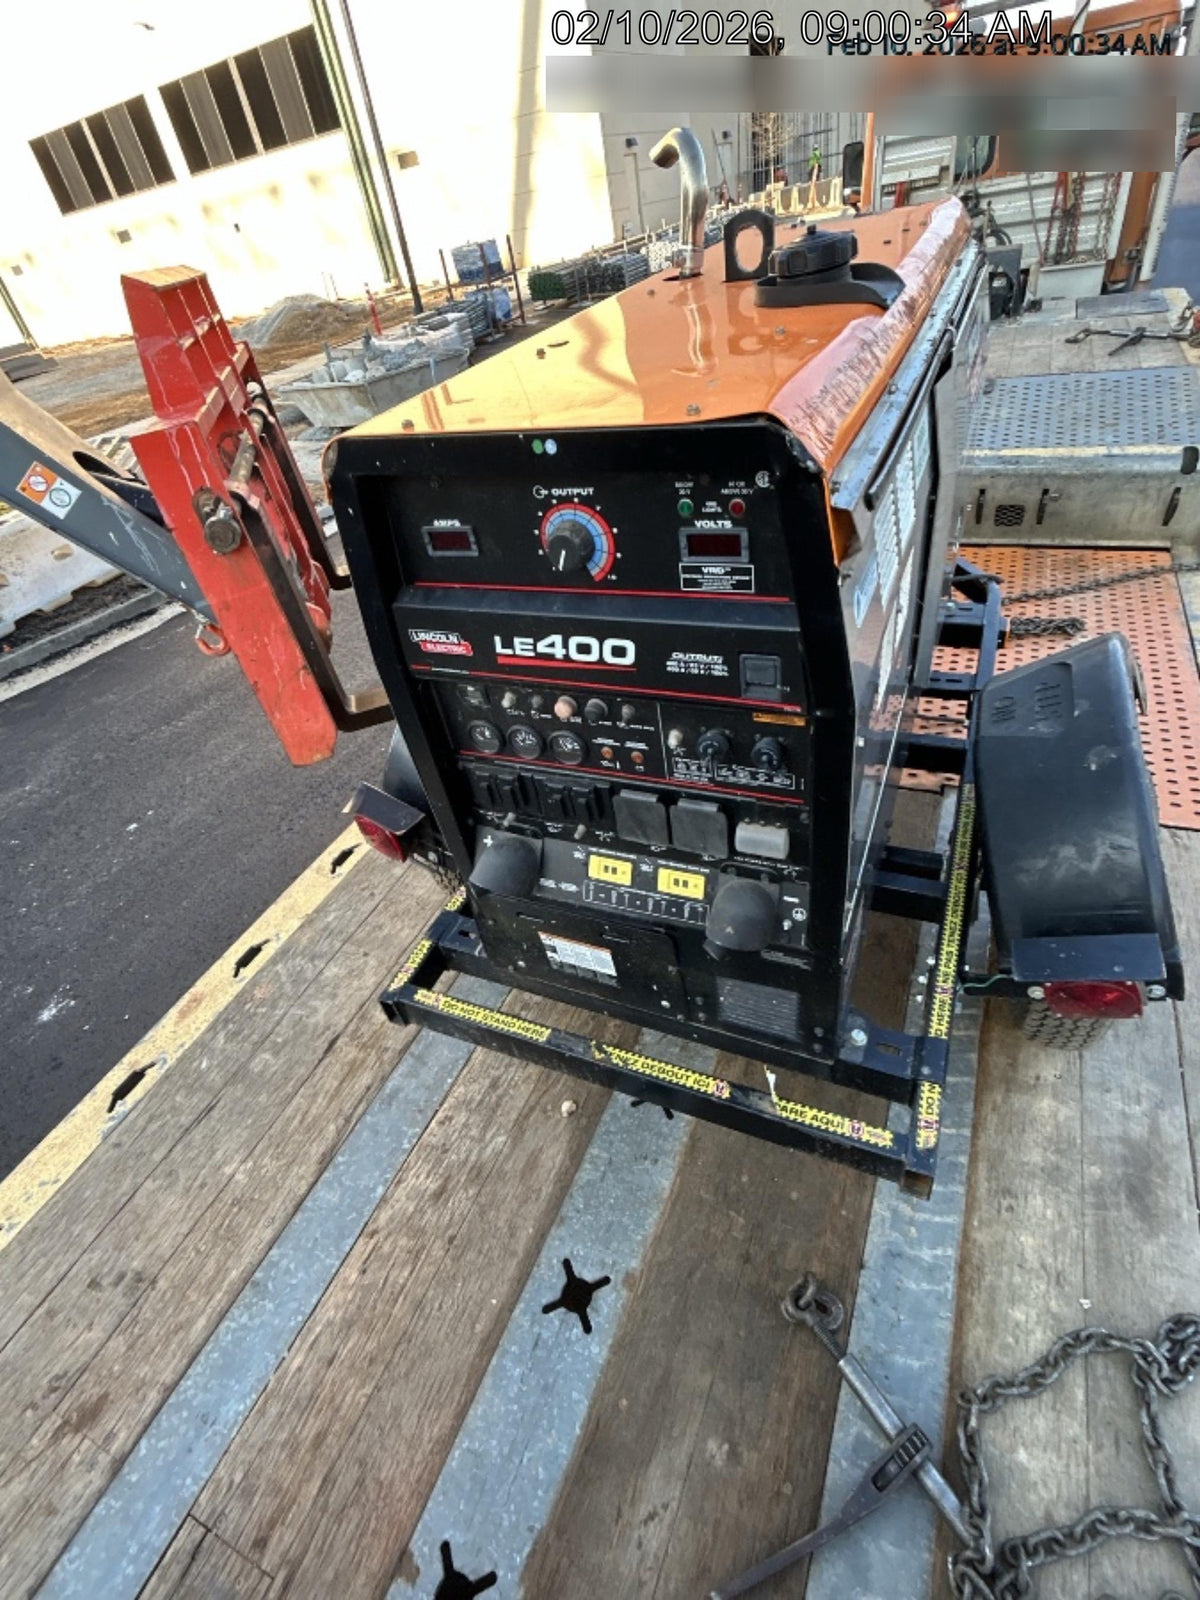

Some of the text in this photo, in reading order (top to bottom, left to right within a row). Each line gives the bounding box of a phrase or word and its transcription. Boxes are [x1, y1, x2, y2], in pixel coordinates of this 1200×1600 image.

[551, 486, 595, 496] OUTPUT
[694, 520, 733, 529] VOLTS
[493, 633, 636, 666] LE400
[459, 1006, 481, 1018] NOT
[481, 1011, 517, 1029] STAND
[640, 1060, 692, 1082] DEBOUT
[692, 1076, 710, 1089] ICI
